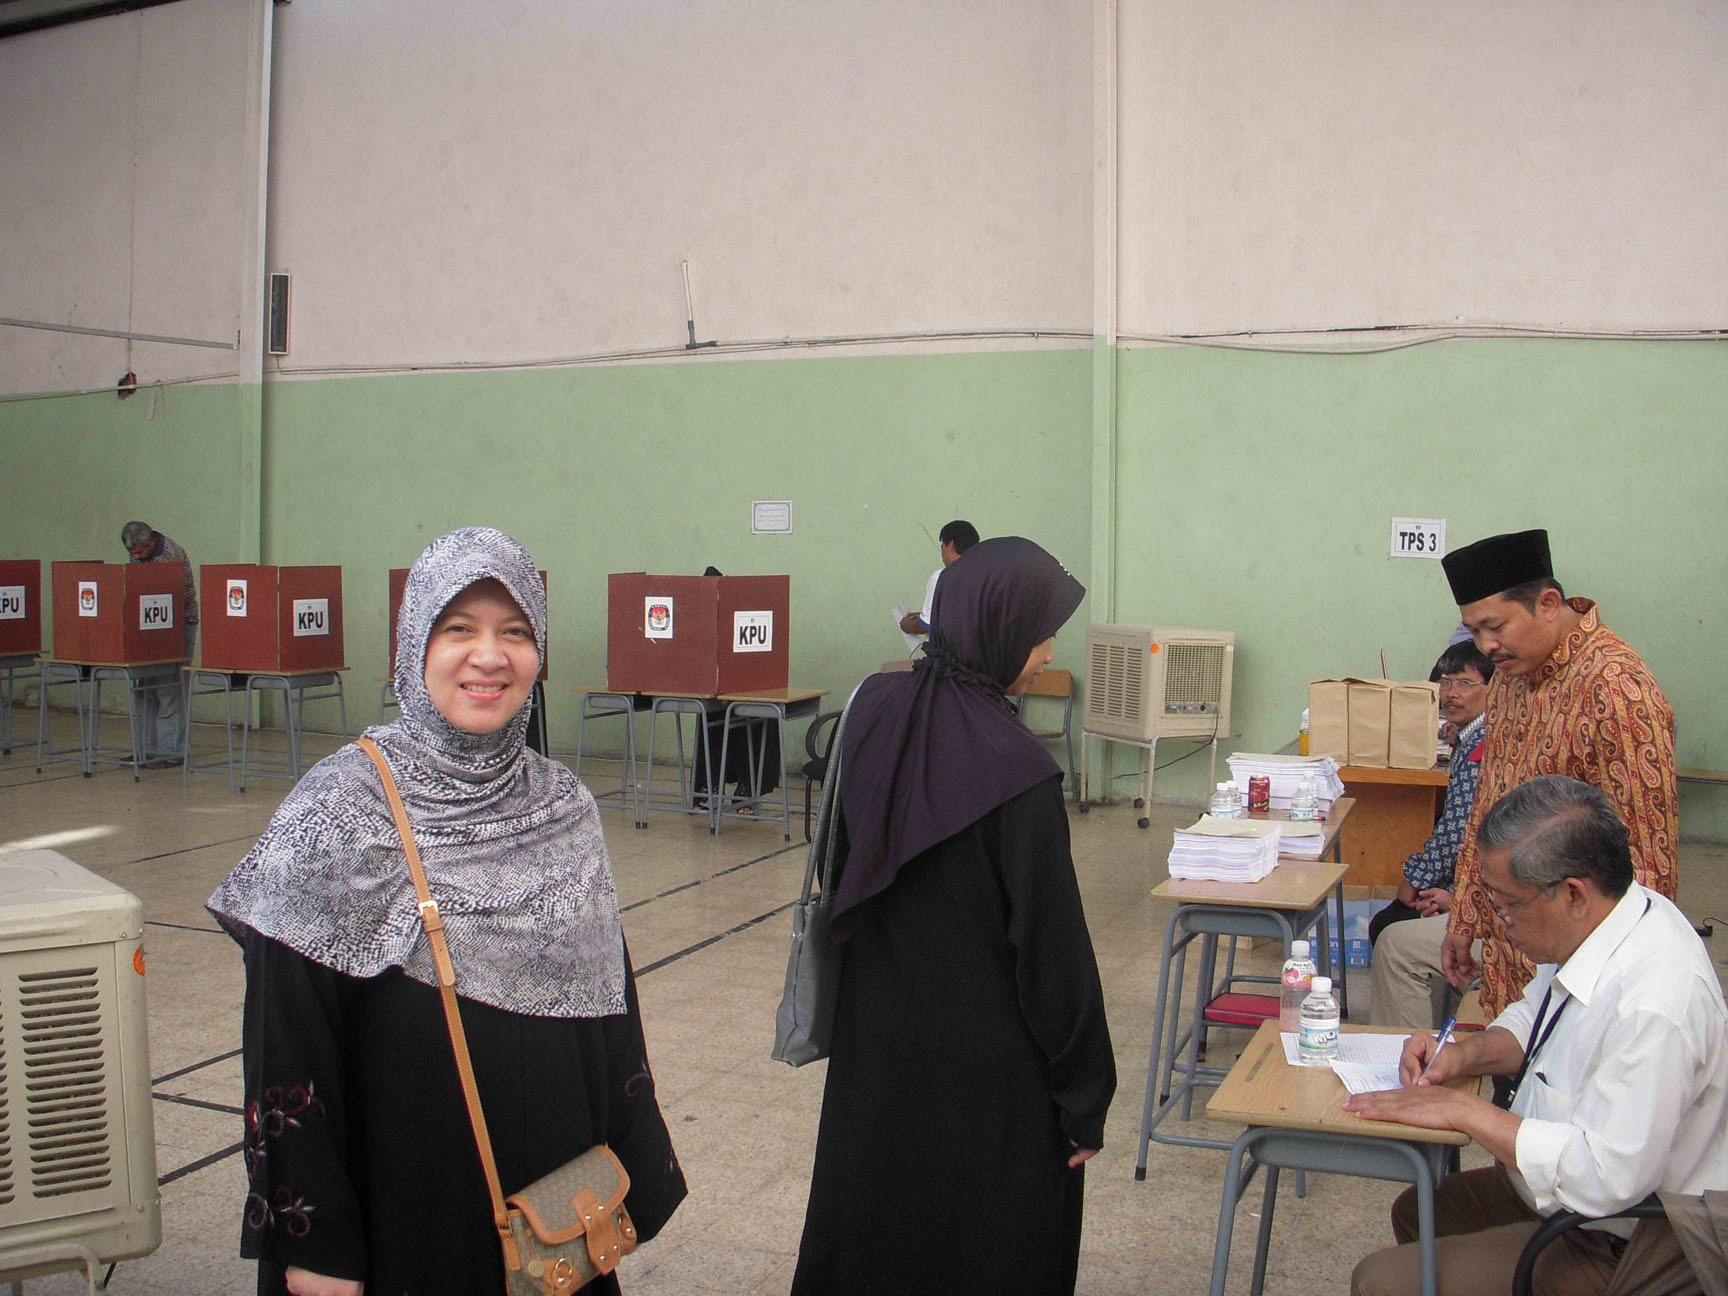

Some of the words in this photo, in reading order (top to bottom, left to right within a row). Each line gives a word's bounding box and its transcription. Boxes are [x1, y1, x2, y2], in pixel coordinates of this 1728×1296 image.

[1400, 532, 1425, 551] TPS
[1429, 533, 1437, 552] 3
[144, 606, 168, 624] KPU
[298, 611, 324, 630] KPU
[739, 625, 767, 645] KPU
